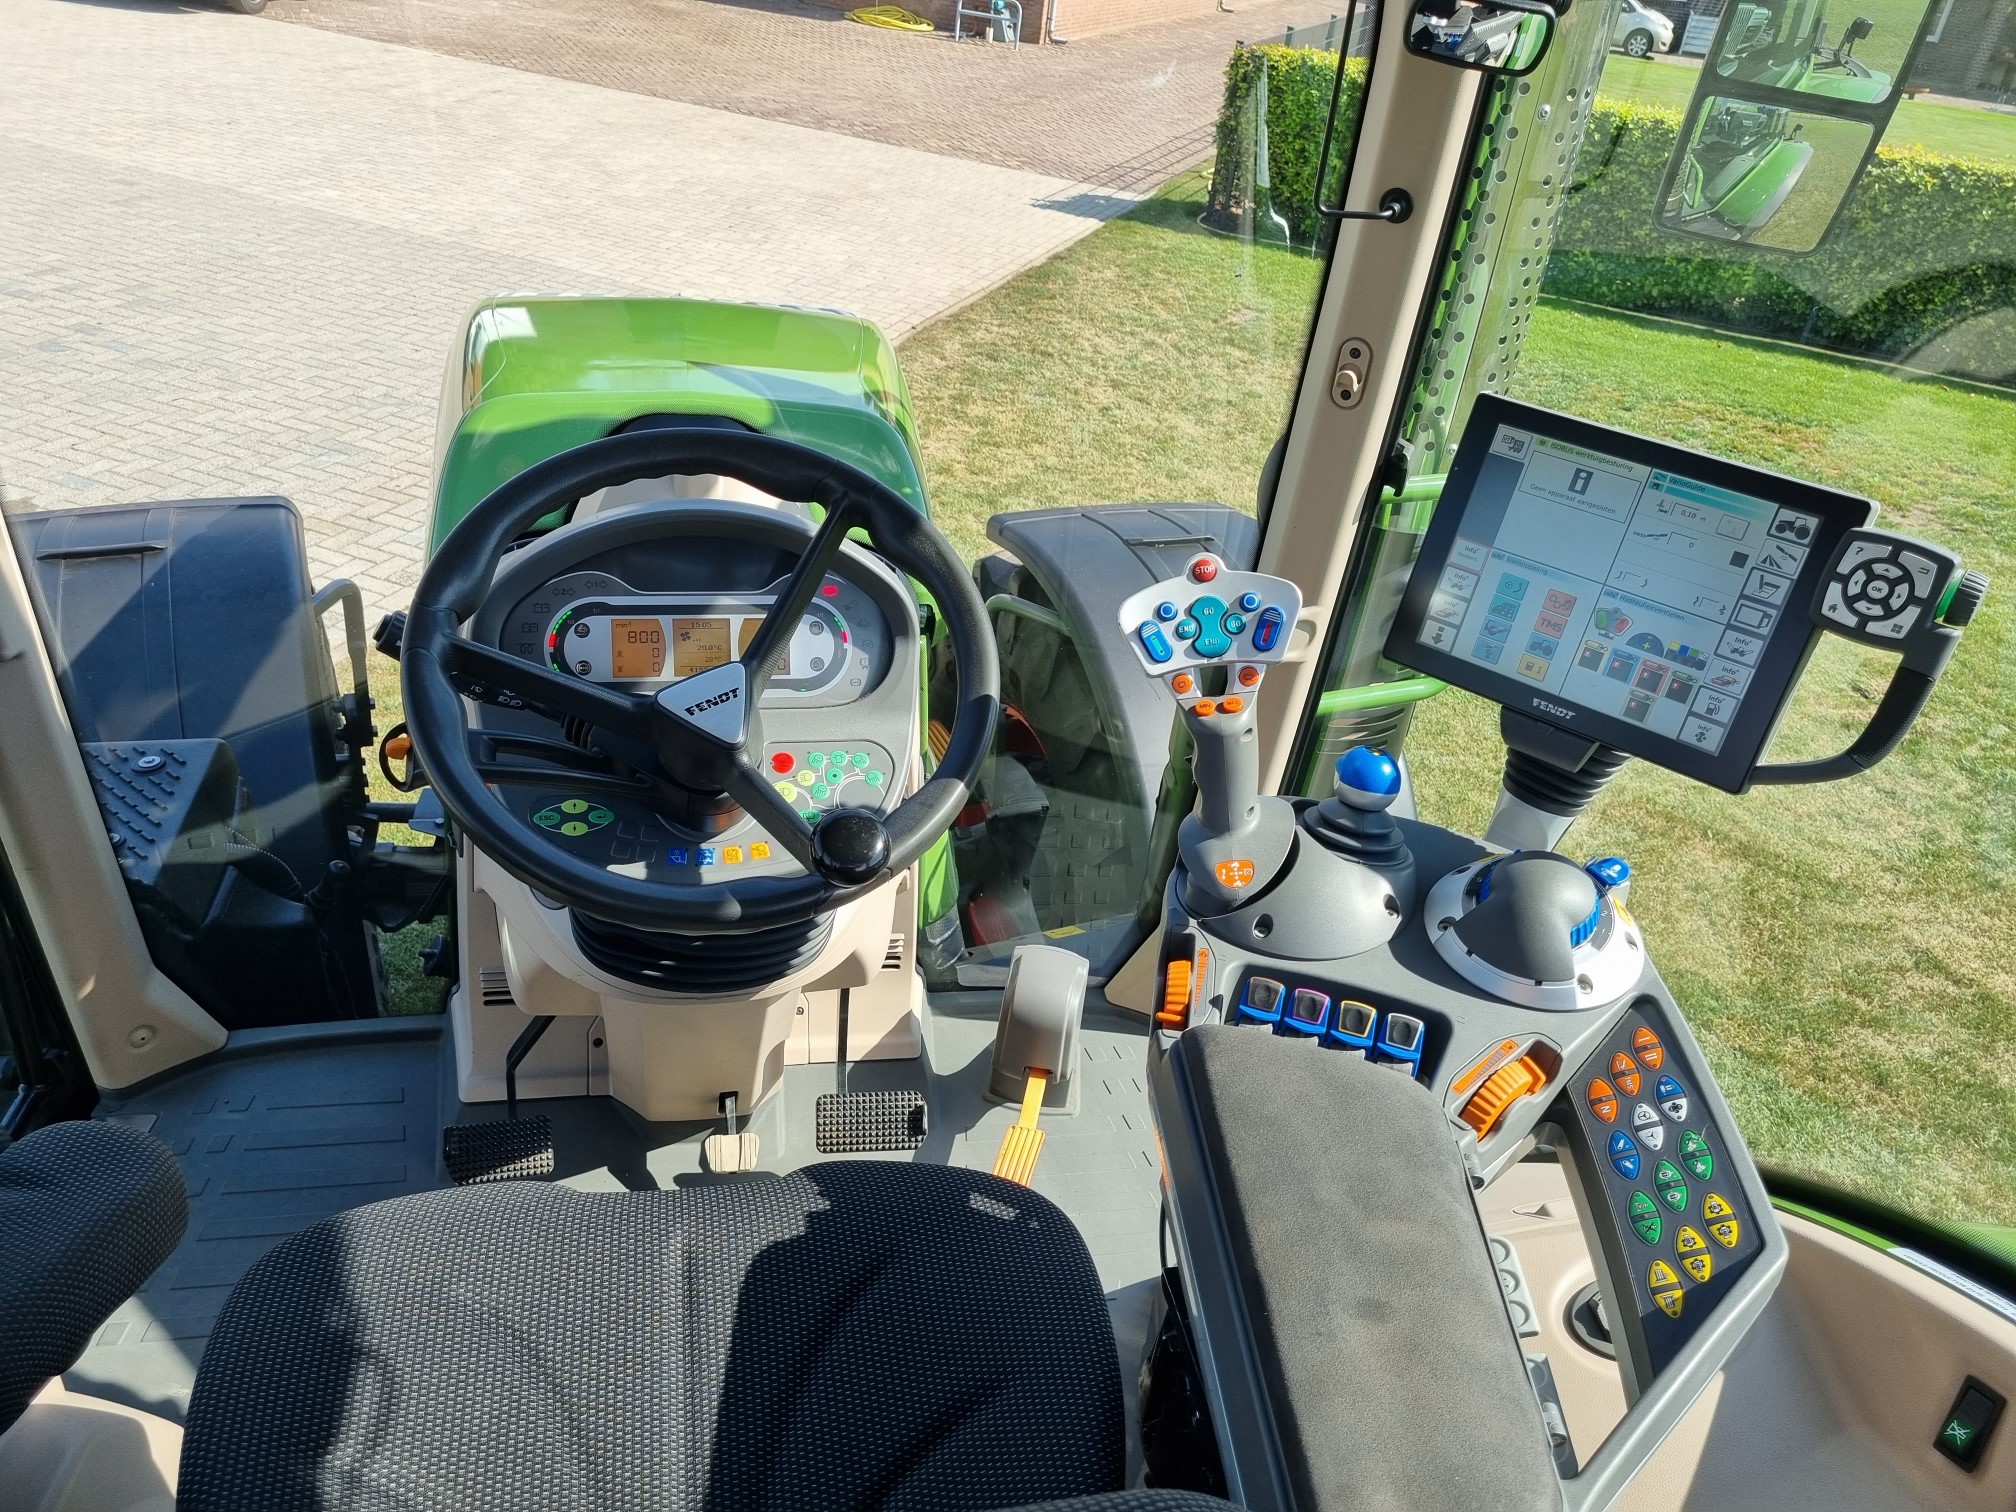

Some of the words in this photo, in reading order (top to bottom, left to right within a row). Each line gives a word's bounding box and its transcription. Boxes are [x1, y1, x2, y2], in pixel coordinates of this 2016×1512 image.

[1668, 476, 1706, 493] VarioGuide
[1530, 483, 1547, 493] Geen
[1548, 489, 1576, 503] apparaat
[1680, 509, 1696, 519] 0,10
[1195, 566, 1215, 574] STOP
[1871, 585, 1883, 594] OK
[1178, 625, 1194, 633] END
[1540, 617, 1563, 632] TMS
[628, 631, 660, 643] 800
[1204, 638, 1220, 646] END
[652, 647, 660, 658] 0
[652, 661, 660, 673] 0
[684, 687, 739, 716] FENDT
[1532, 697, 1576, 720] FENDT
